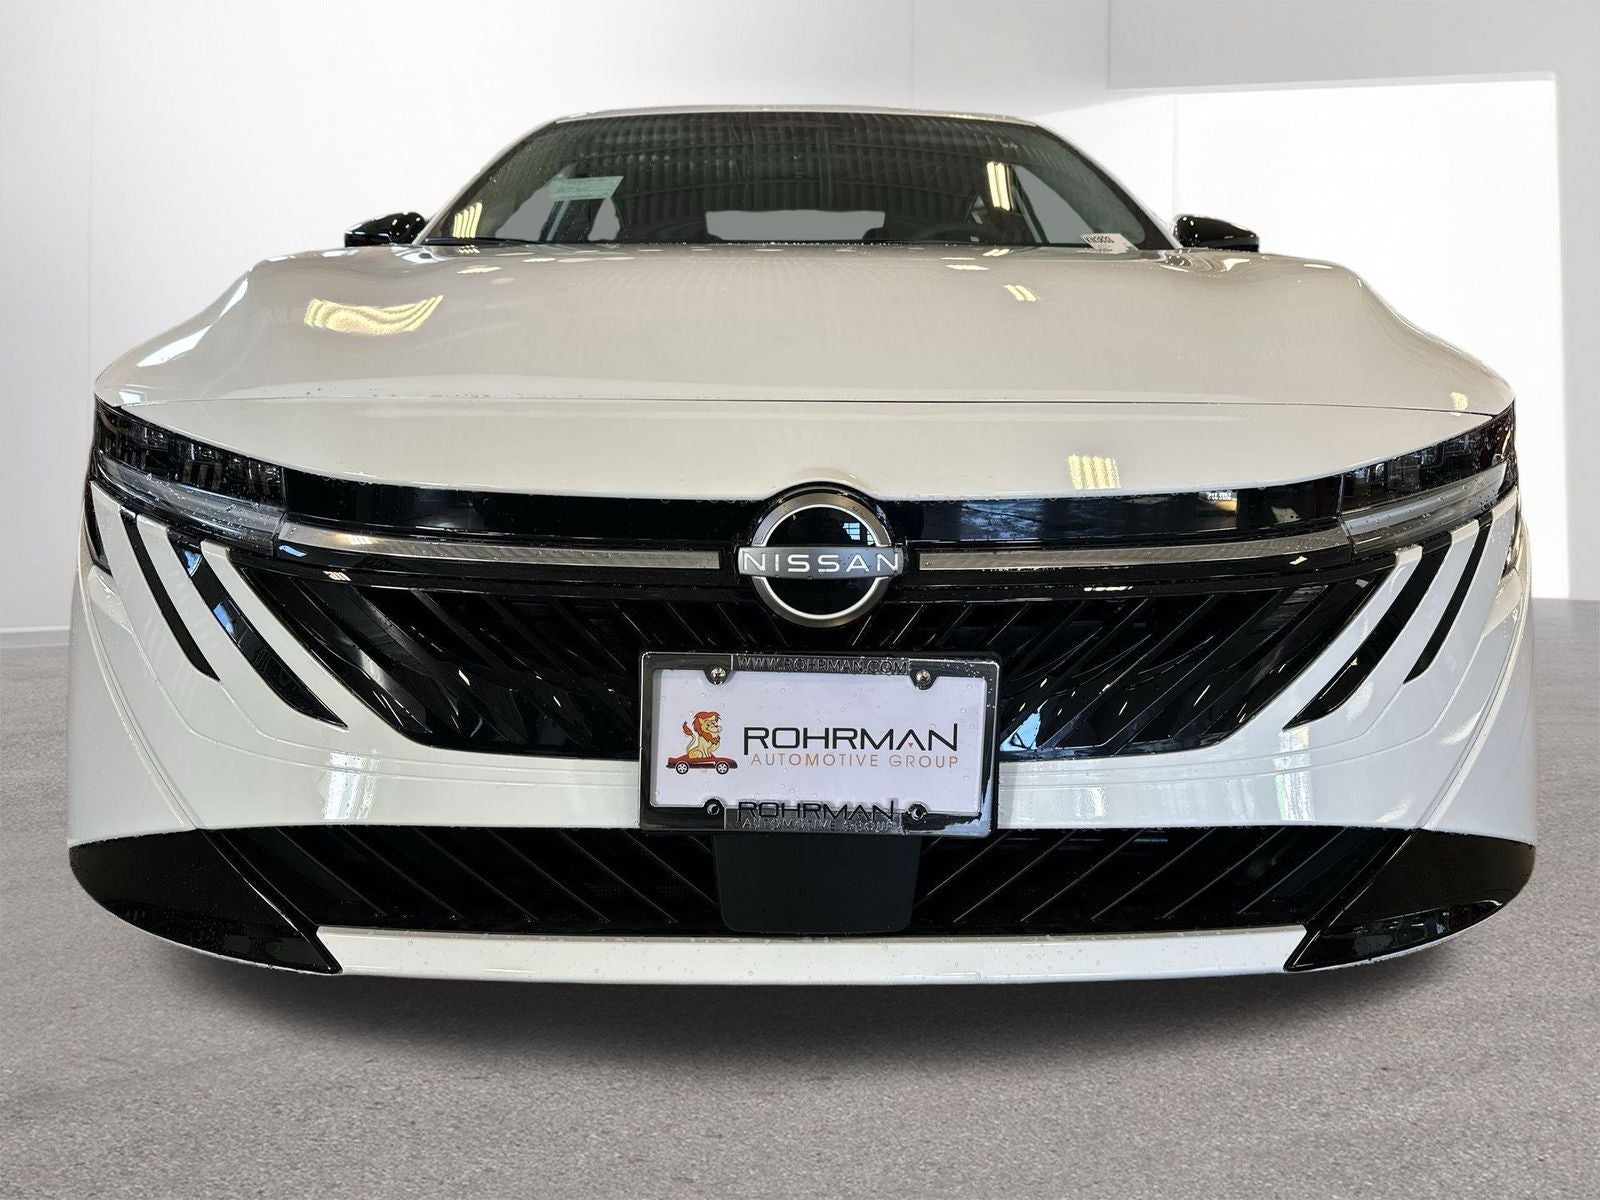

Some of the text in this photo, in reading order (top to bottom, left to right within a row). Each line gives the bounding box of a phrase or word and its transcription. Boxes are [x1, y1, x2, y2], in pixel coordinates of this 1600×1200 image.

[743, 552, 899, 573] NISSAN
[737, 656, 908, 674] WWW.ROHRMAN.COM
[743, 723, 958, 755] ROHRMAN
[751, 753, 959, 769] AUTOMOTIVE GROUP
[738, 800, 894, 821] ROHRMAN
[742, 817, 894, 832] AUTOMOTIVE GROUP
